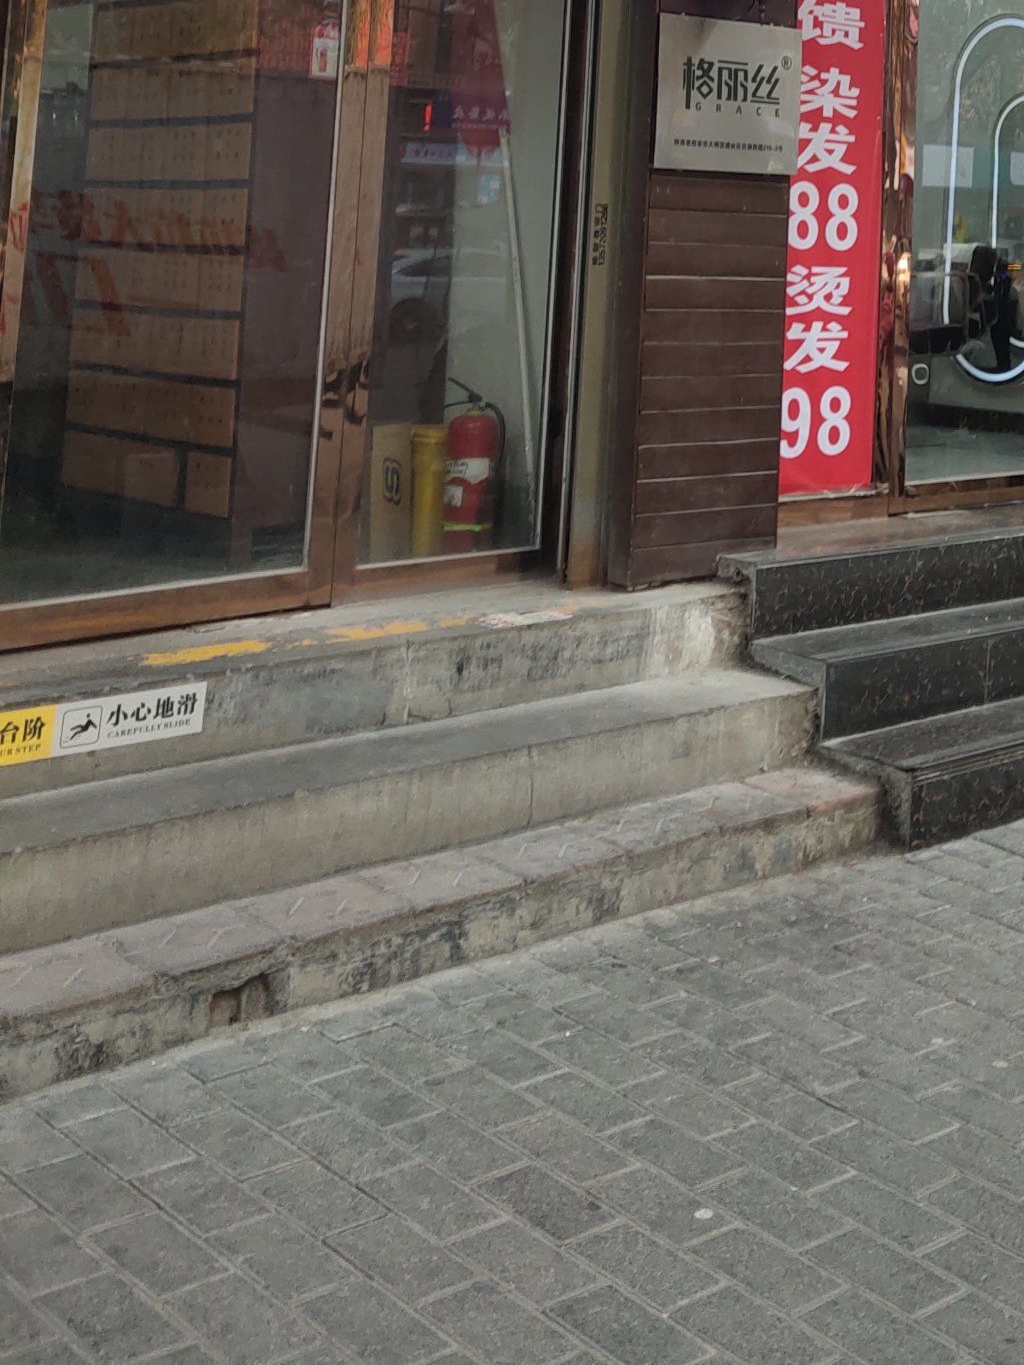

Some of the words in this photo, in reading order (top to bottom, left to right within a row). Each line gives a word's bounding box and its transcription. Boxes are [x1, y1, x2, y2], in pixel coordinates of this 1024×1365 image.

[683, 56, 780, 109] 格丽丝
[695, 102, 780, 118] GRACE
[106, 692, 198, 728] 小心地滑
[163, 719, 191, 730] SLIDE
[16, 744, 41, 753] STEP
